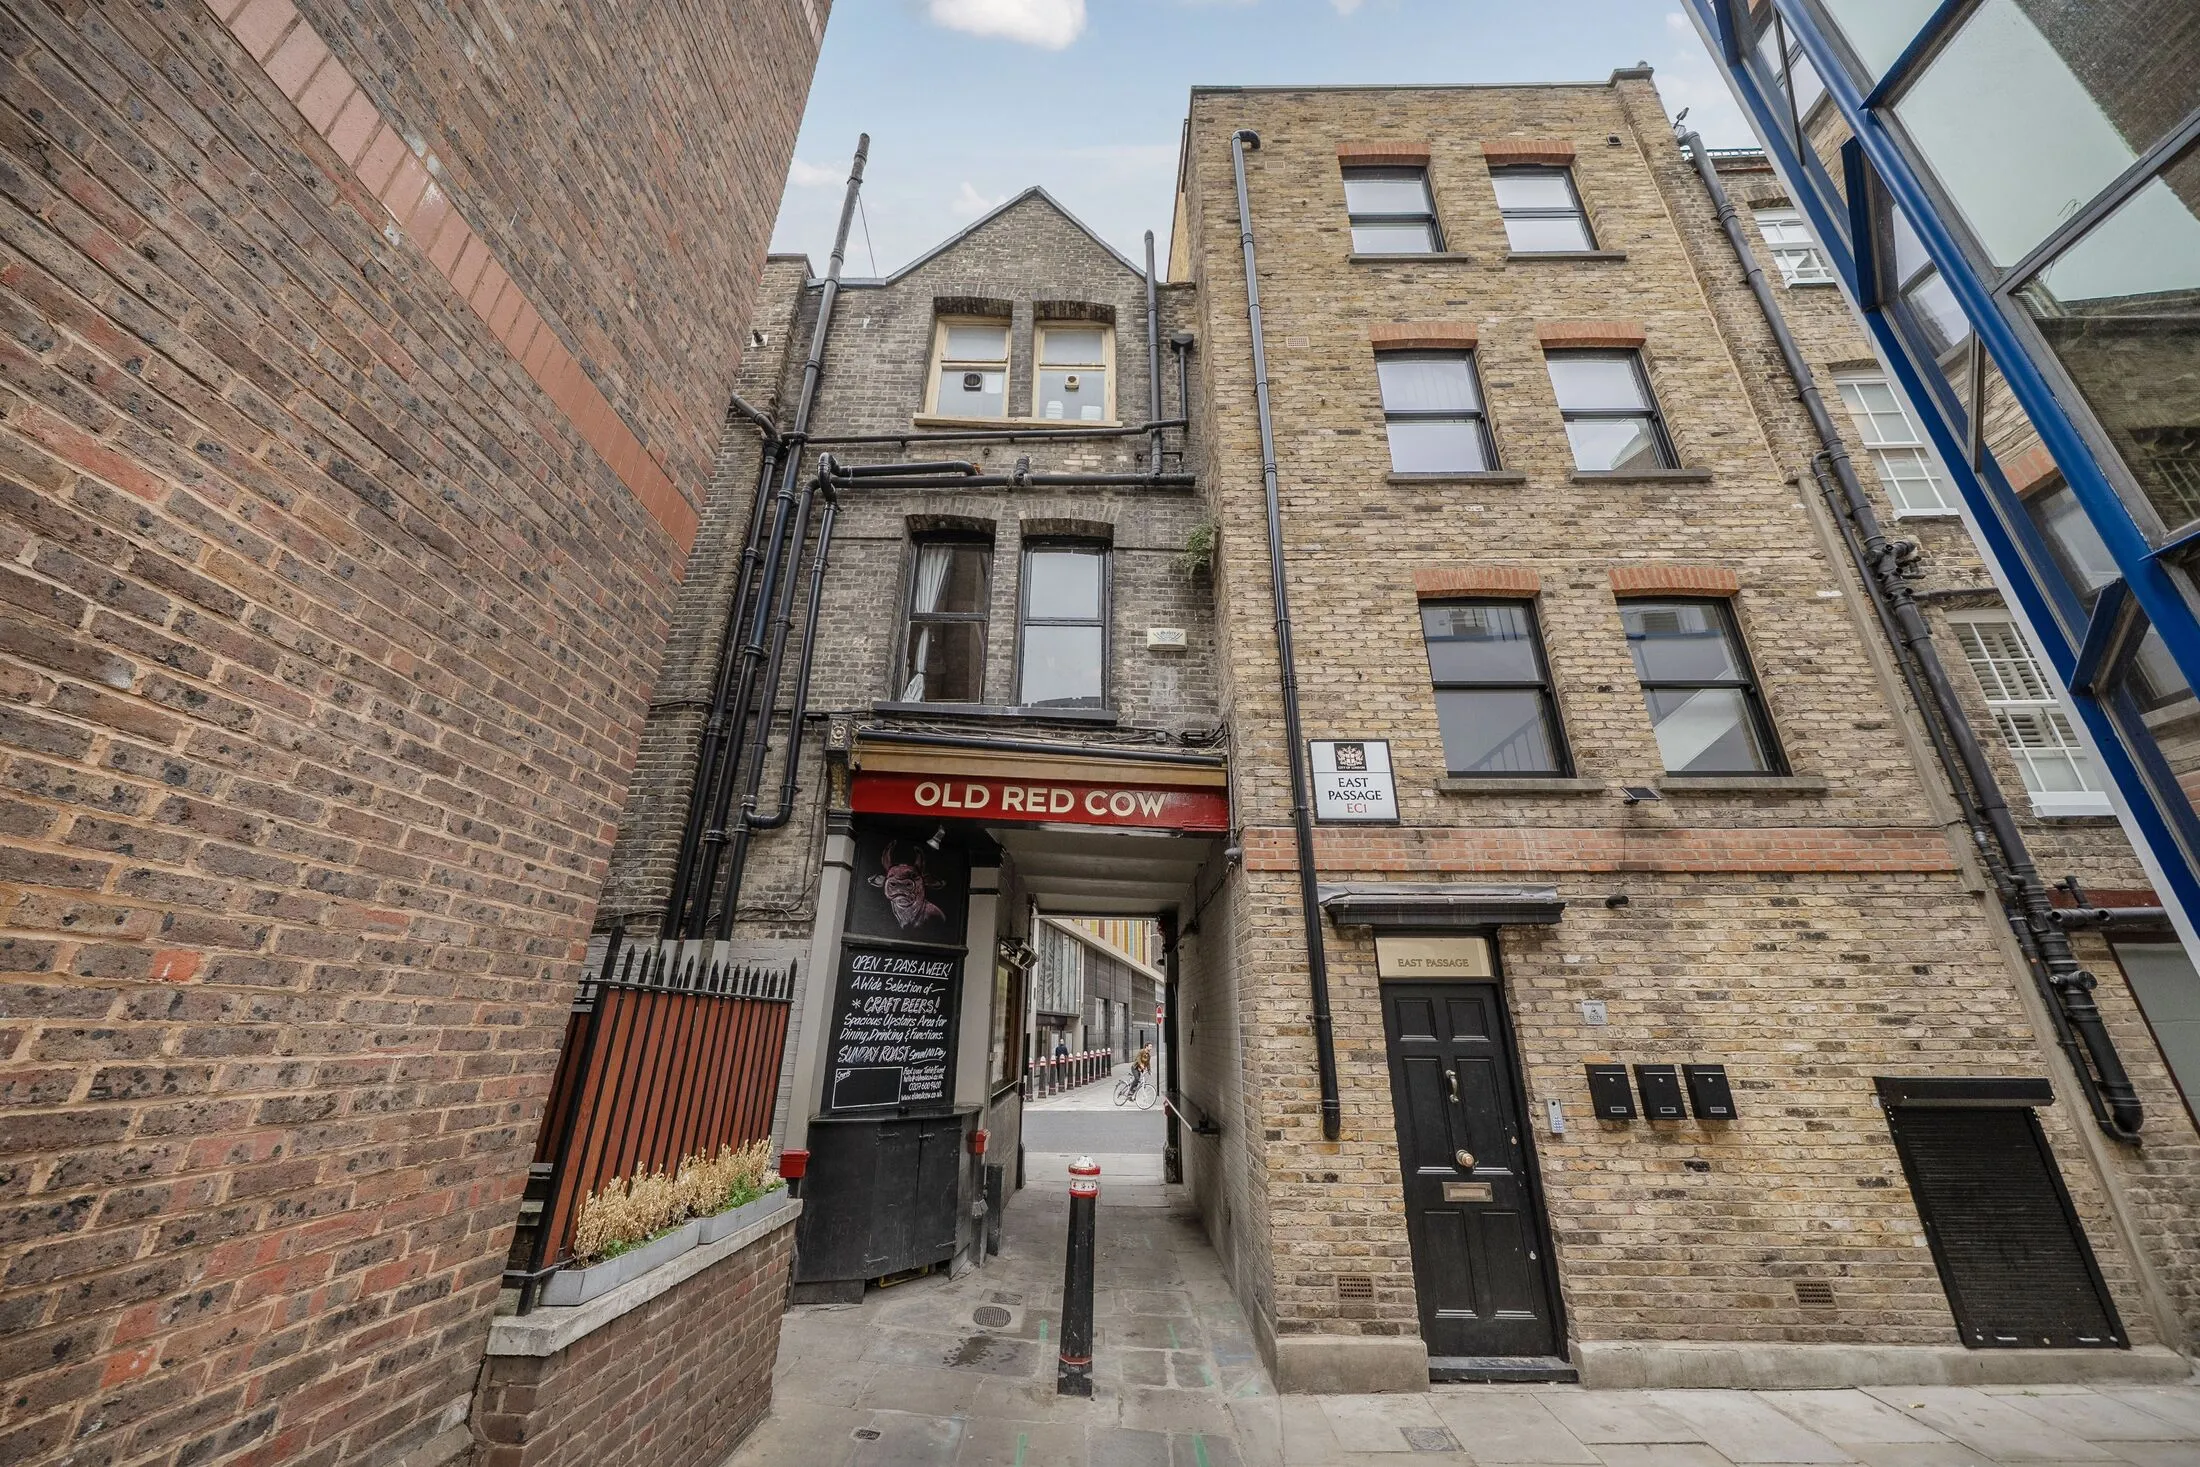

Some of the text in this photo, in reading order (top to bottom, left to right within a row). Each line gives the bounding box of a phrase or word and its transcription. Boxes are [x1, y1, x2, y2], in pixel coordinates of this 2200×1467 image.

[1338, 777, 1368, 788] EAST
[914, 781, 1169, 818] OLD RED COW
[1328, 790, 1382, 800] PASSAGE
[1346, 803, 1367, 813] EC1
[852, 955, 954, 977] OPEN 7 DAYS A WEEK!
[1398, 959, 1469, 967] EAST PASSAGE
[851, 975, 861, 989] A
[861, 976, 882, 991] Wide
[885, 977, 922, 994] Selection
[863, 996, 941, 1014] CRAFT BEERS!
[843, 1012, 947, 1028] Spacious Upstairs Area for
[868, 1028, 904, 1043] Drinking
[837, 1045, 911, 1063] SUNDAY ROAST
